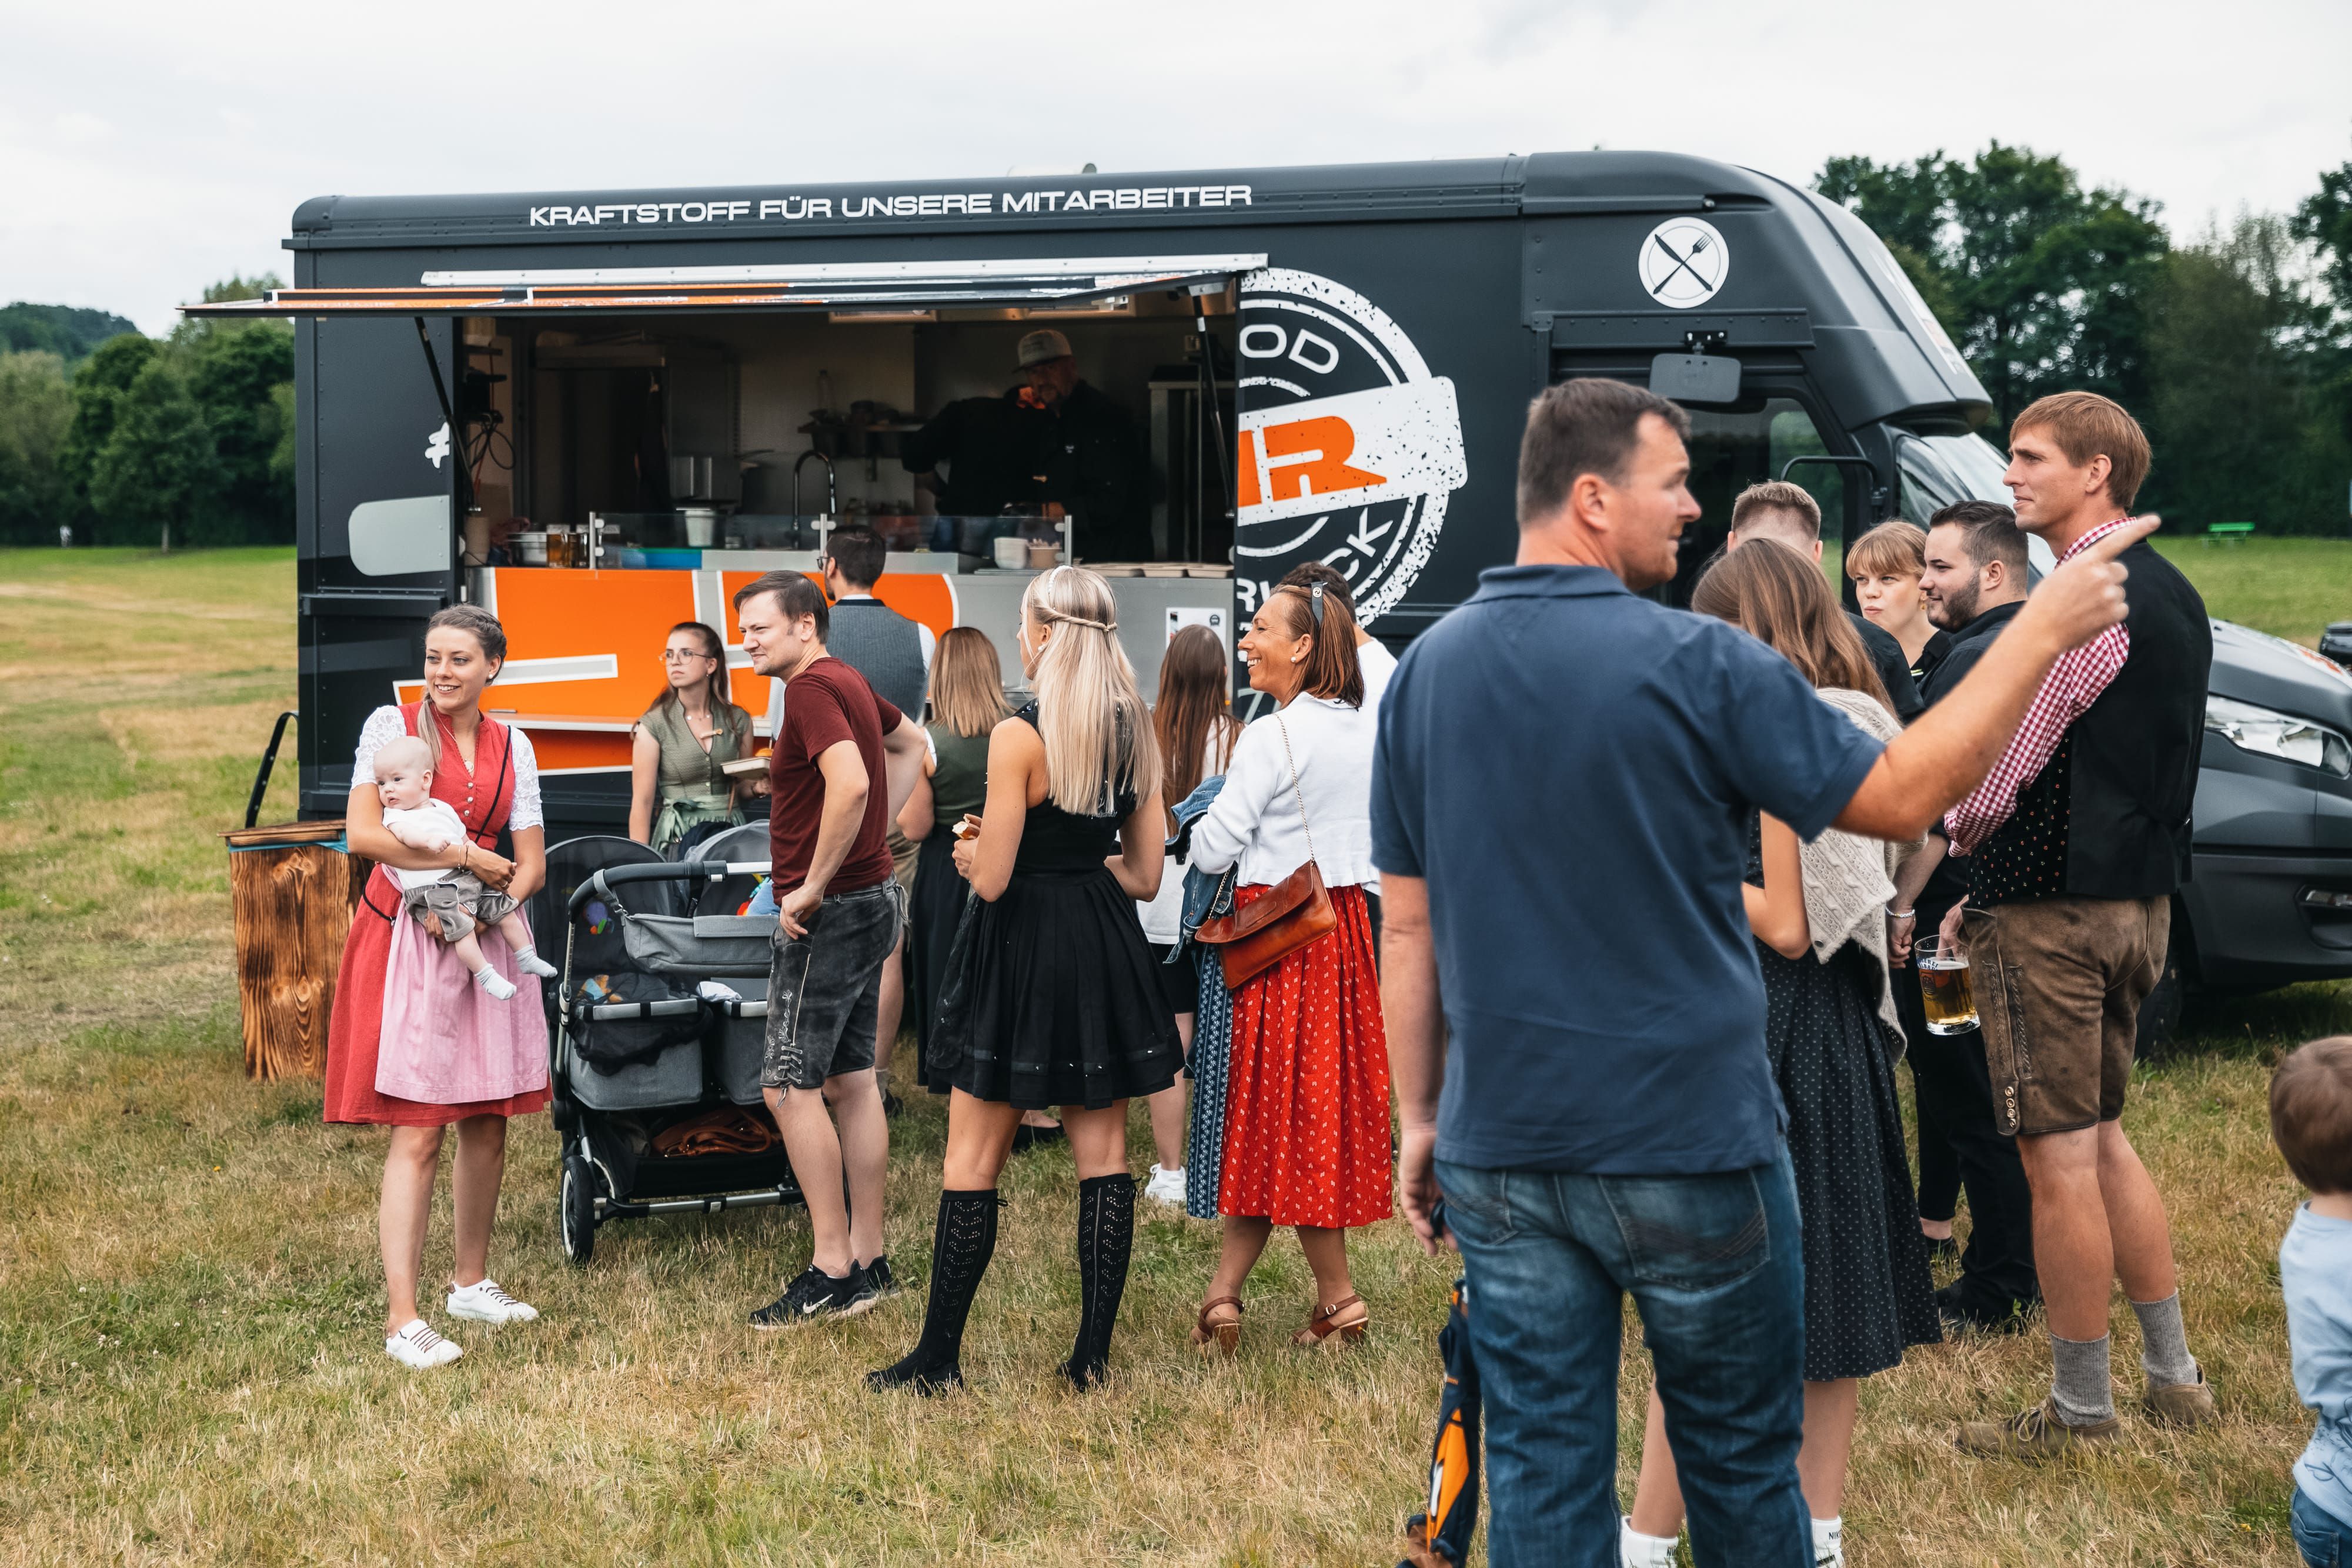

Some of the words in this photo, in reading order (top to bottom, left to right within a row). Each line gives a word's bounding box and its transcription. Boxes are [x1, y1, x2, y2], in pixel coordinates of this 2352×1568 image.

[530, 200, 751, 226] KRAFTSTOFF
[760, 195, 833, 220] FÜR
[841, 193, 993, 218] UNSERE
[1001, 185, 1252, 213] MITARBEITER
[1237, 507, 1394, 613] RCK
